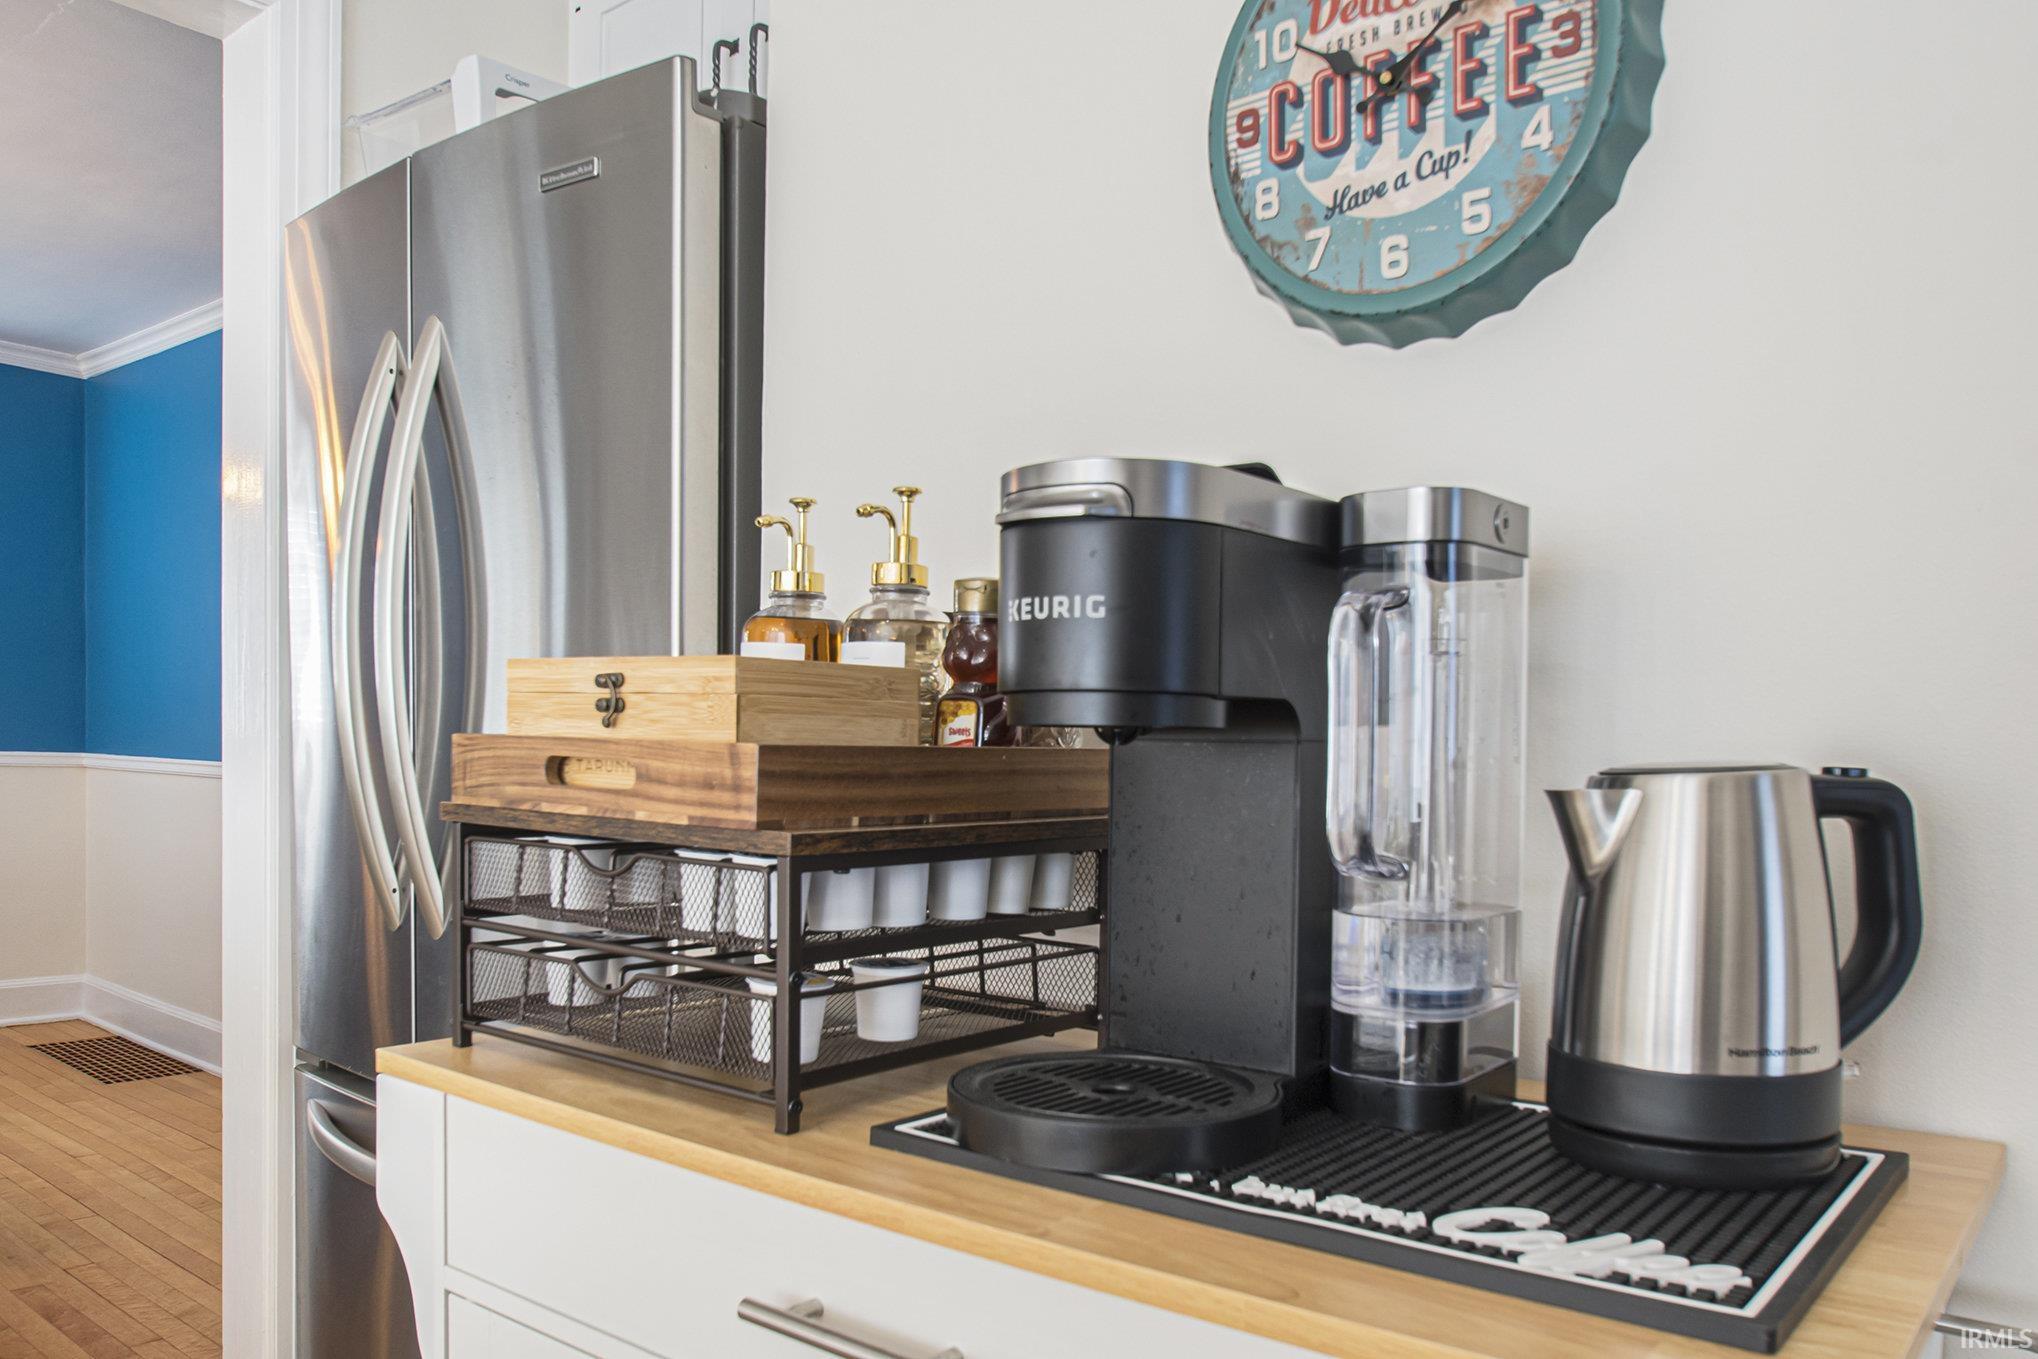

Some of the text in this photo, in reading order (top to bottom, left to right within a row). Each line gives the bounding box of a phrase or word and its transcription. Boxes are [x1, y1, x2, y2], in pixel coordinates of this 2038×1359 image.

[1254, 20, 1298, 70] 10
[1325, 26, 1380, 54] FRESH
[1550, 10, 1581, 59] 3
[1268, 4, 1542, 168] COFFEE
[1235, 108, 1261, 149] 9
[1521, 105, 1554, 151] 4
[1324, 130, 1473, 220] Have a Cup!
[1254, 178, 1280, 220] 8
[1461, 187, 1493, 236] 5
[1305, 226, 1332, 272] 7
[1380, 234, 1409, 279] 6
[1008, 594, 1106, 622] KEURIG
